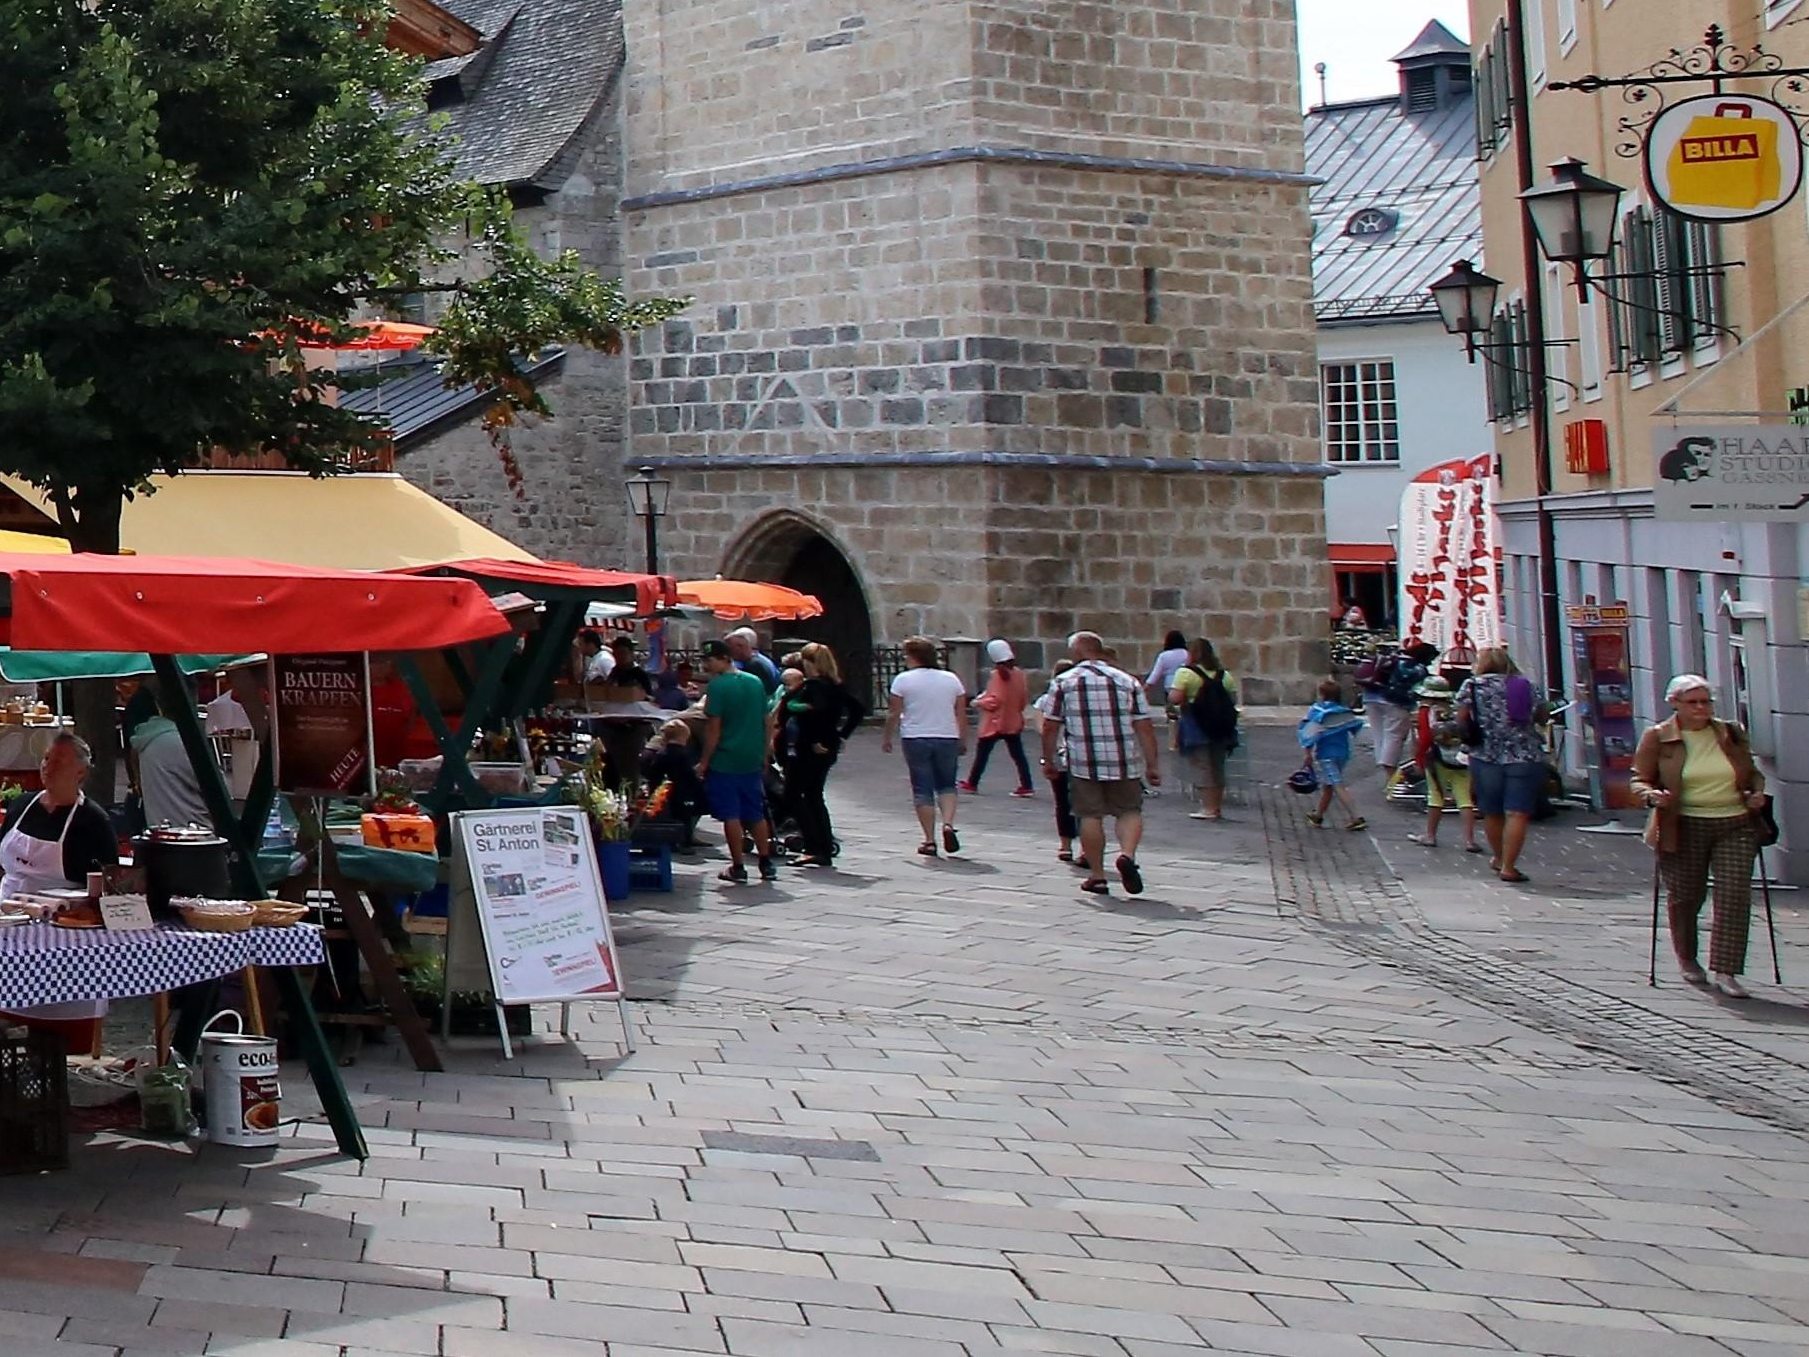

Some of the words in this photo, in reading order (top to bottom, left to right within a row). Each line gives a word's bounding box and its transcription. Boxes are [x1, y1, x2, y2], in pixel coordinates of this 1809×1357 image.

[1684, 138, 1756, 159] BILLA
[1720, 456, 1809, 471] STUDI
[284, 671, 357, 689] BAUERN
[280, 689, 362, 706] KRAPFEN
[330, 746, 361, 783] HEUTE
[474, 821, 537, 837] Gärtnerei
[476, 838, 497, 852] St.
[498, 838, 540, 852] Anton
